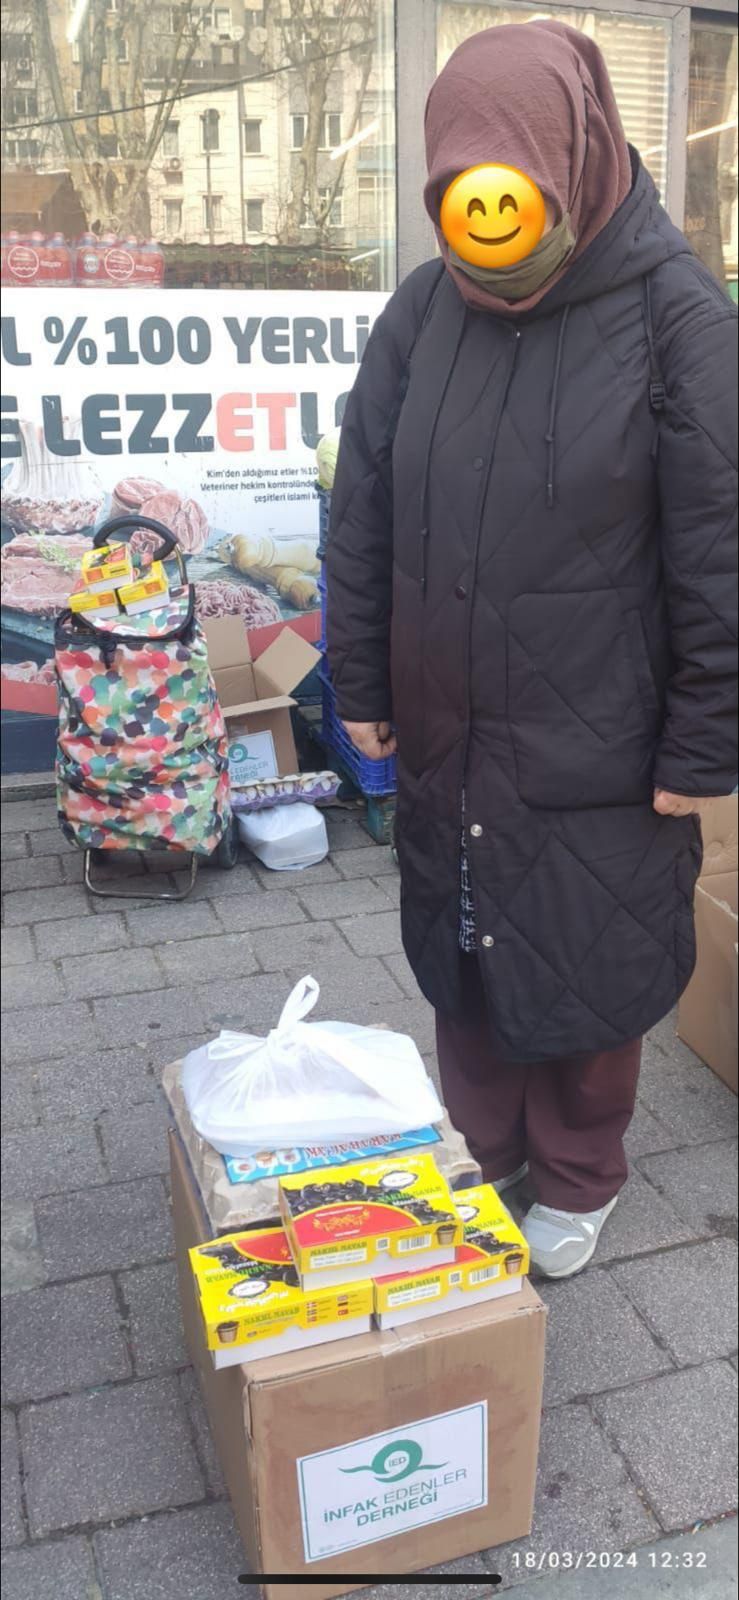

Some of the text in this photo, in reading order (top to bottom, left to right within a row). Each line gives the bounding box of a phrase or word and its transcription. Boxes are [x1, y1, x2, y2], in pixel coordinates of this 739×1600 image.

[43, 315, 212, 366] %100
[41, 391, 352, 457] LEZZETL
[200, 482, 239, 492] Veteriner
[240, 481, 266, 490] hekim
[206, 469, 241, 479] Kim'den
[241, 468, 278, 479] aldığımız
[279, 468, 299, 476] etler
[254, 492, 286, 503] çeşitleri
[323, 1468, 468, 1523] İNFAK EDENLER
[356, 1490, 438, 1527] DERNEĞİ
